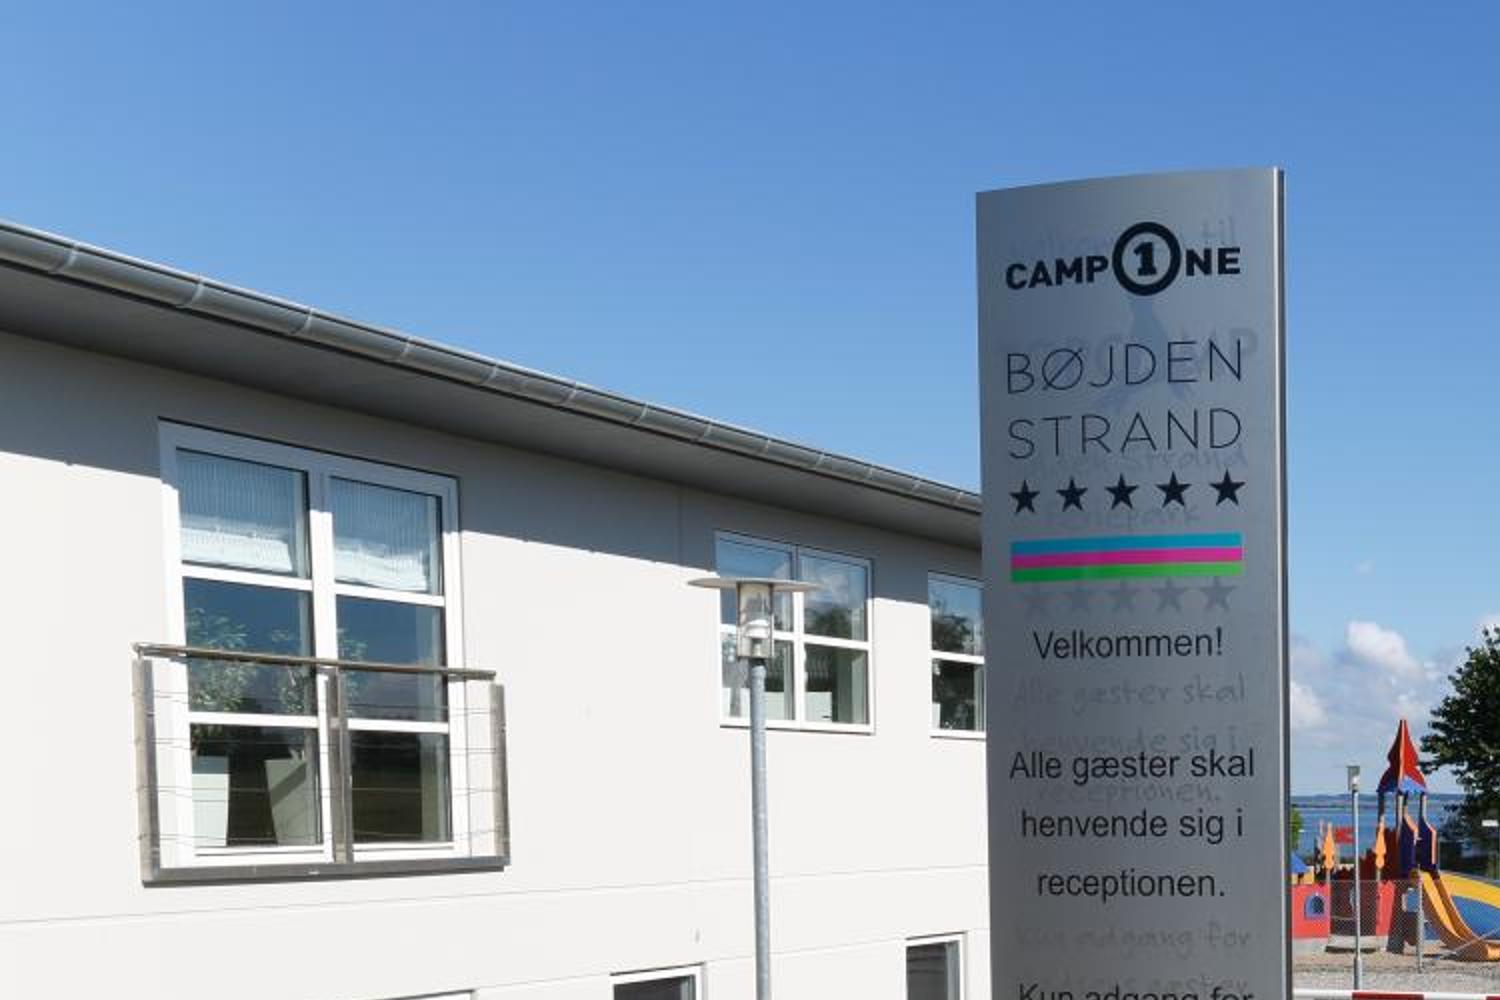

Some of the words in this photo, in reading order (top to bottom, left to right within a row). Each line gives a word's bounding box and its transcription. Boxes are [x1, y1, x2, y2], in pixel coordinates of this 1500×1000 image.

[1007, 338, 1242, 394] BØJDEN
[1008, 408, 1242, 459] STRAND
[1033, 626, 1222, 659] Velkommen!
[1009, 751, 1062, 779] Alle
[1072, 751, 1180, 786] gæster
[1191, 747, 1254, 777] skal
[1022, 808, 1167, 837] henvende
[1180, 808, 1224, 844] sig
[1237, 808, 1242, 837] i
[1038, 868, 1224, 903] receptionen.
